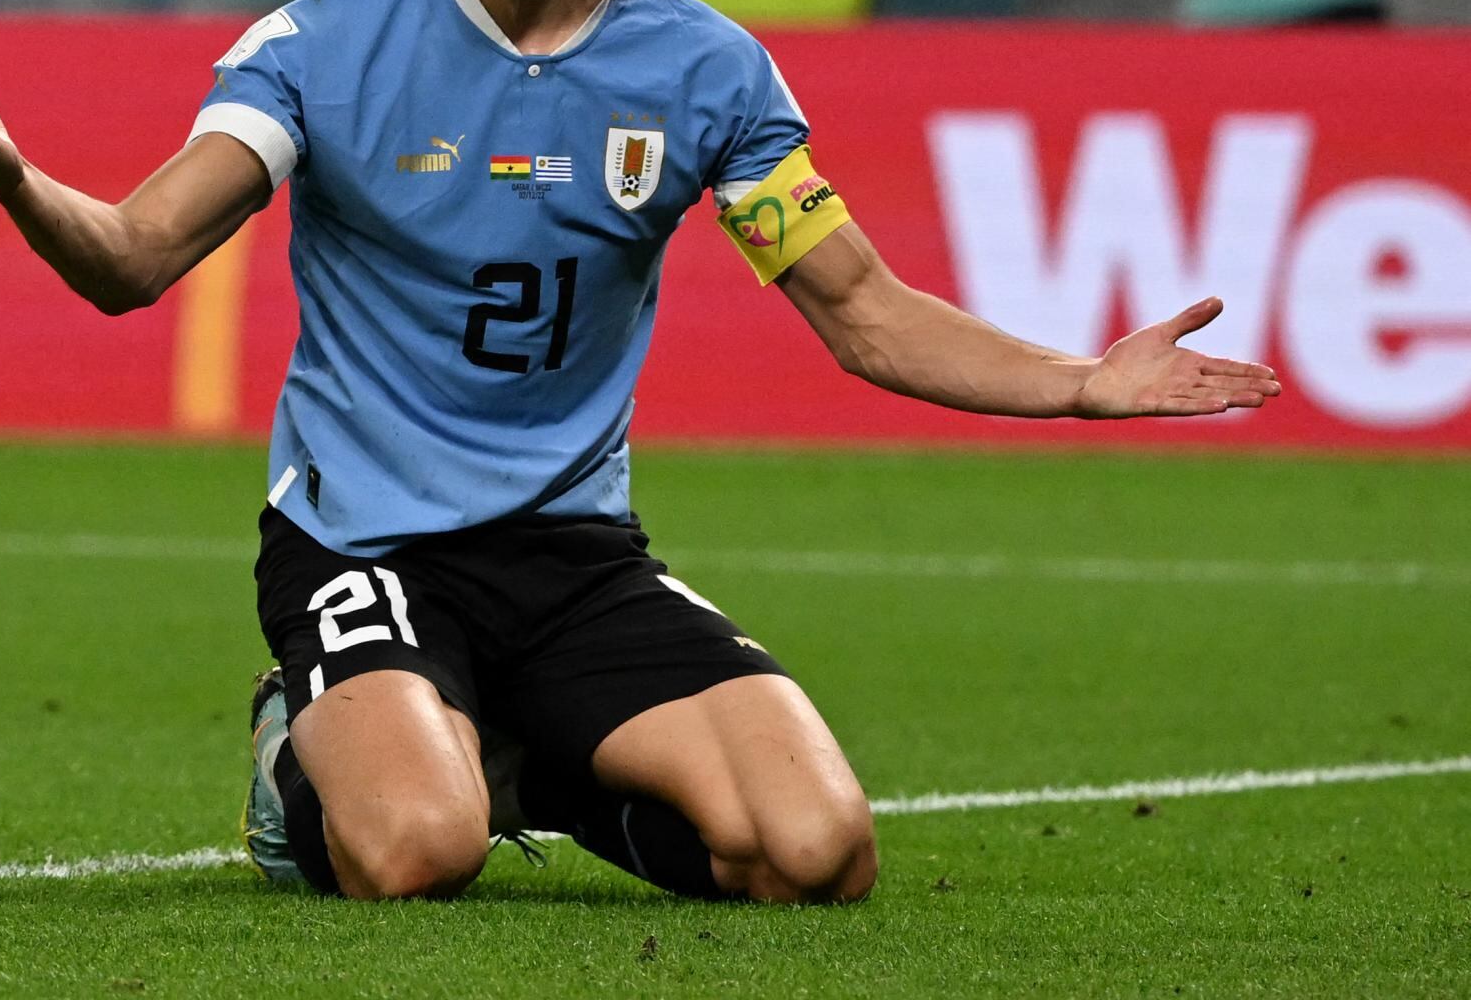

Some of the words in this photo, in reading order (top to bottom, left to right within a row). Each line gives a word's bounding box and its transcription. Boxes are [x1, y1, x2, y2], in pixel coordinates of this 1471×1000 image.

[397, 154, 451, 173] PUMA
[462, 256, 578, 374] 21
[925, 110, 1471, 428] We
[307, 566, 420, 653] 21
